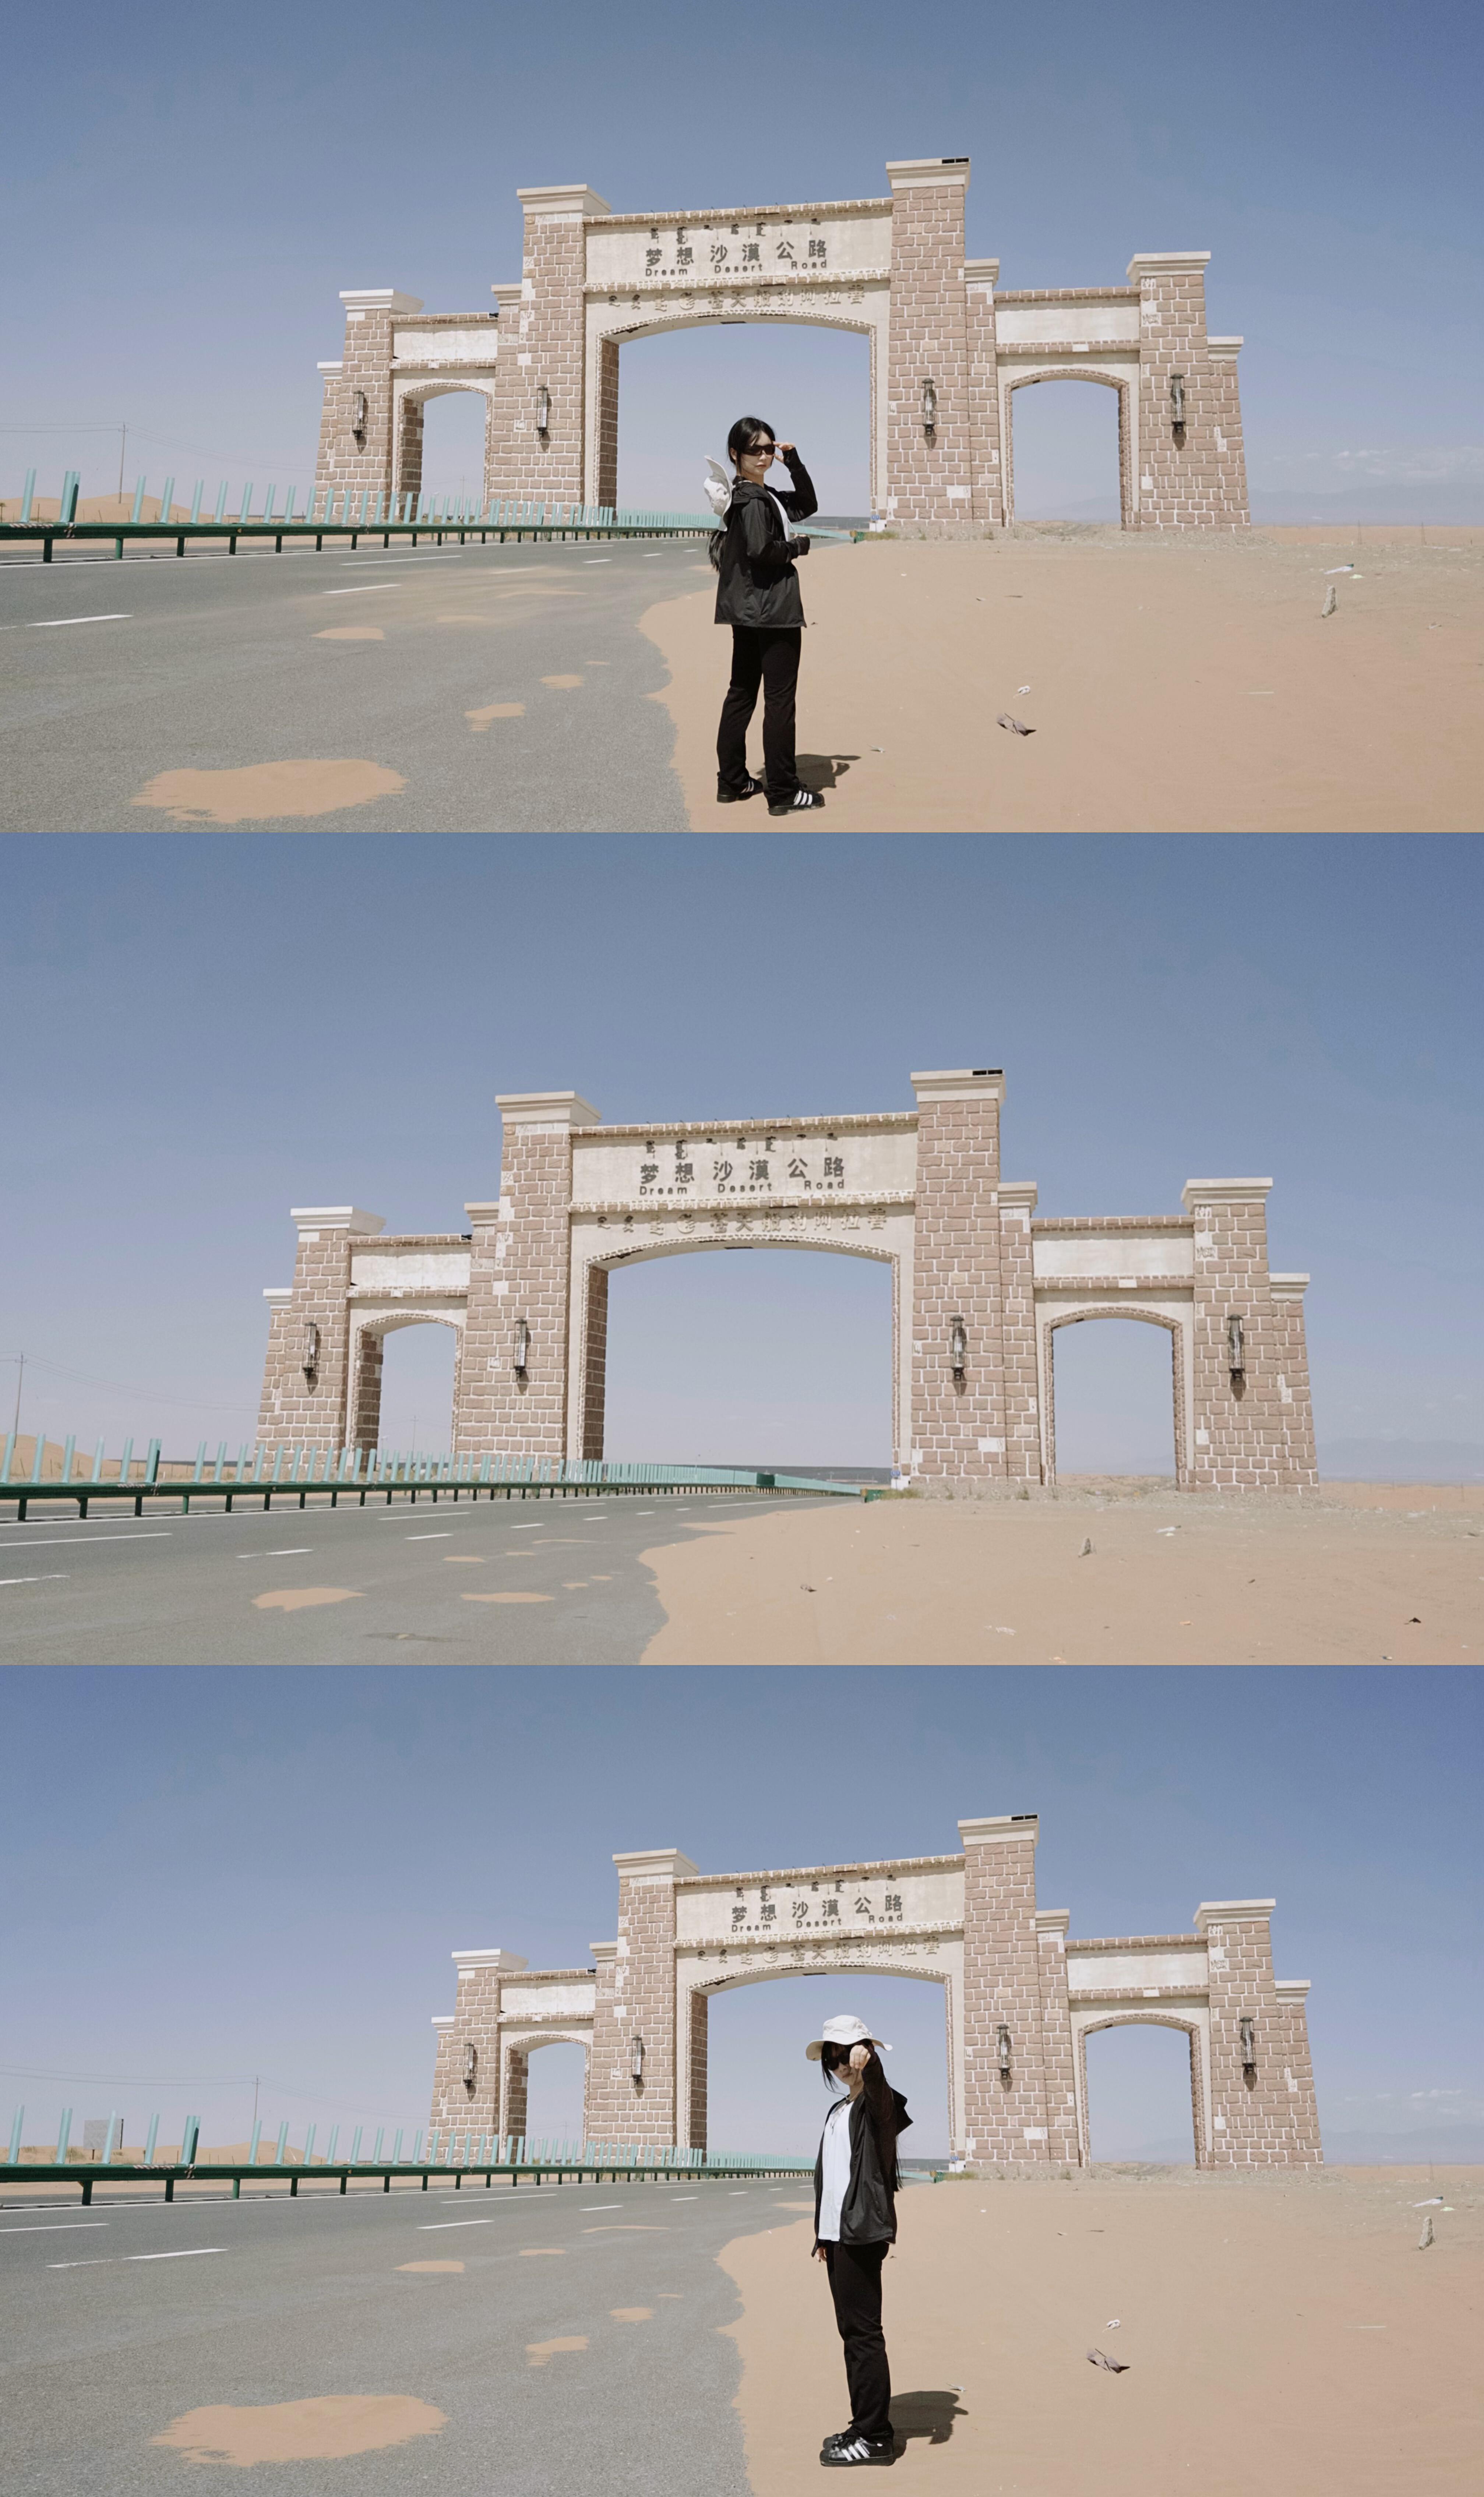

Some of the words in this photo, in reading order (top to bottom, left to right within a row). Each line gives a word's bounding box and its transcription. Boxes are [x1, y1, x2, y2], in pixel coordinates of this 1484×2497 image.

[646, 239, 827, 267] 梦想沙漠公路
[645, 268, 688, 276] Dream
[714, 263, 763, 274] Desert
[791, 259, 827, 270] Road
[640, 1157, 845, 1184] 梦想沙漠公路
[640, 1186, 687, 1195] Dream
[718, 1182, 772, 1193] Desert
[804, 1179, 845, 1190] Road
[732, 1894, 902, 1923] 梦想沙漠公路
[732, 1923, 771, 1933] Dream
[796, 1918, 842, 1929] Desert
[869, 1913, 902, 1923] Road
